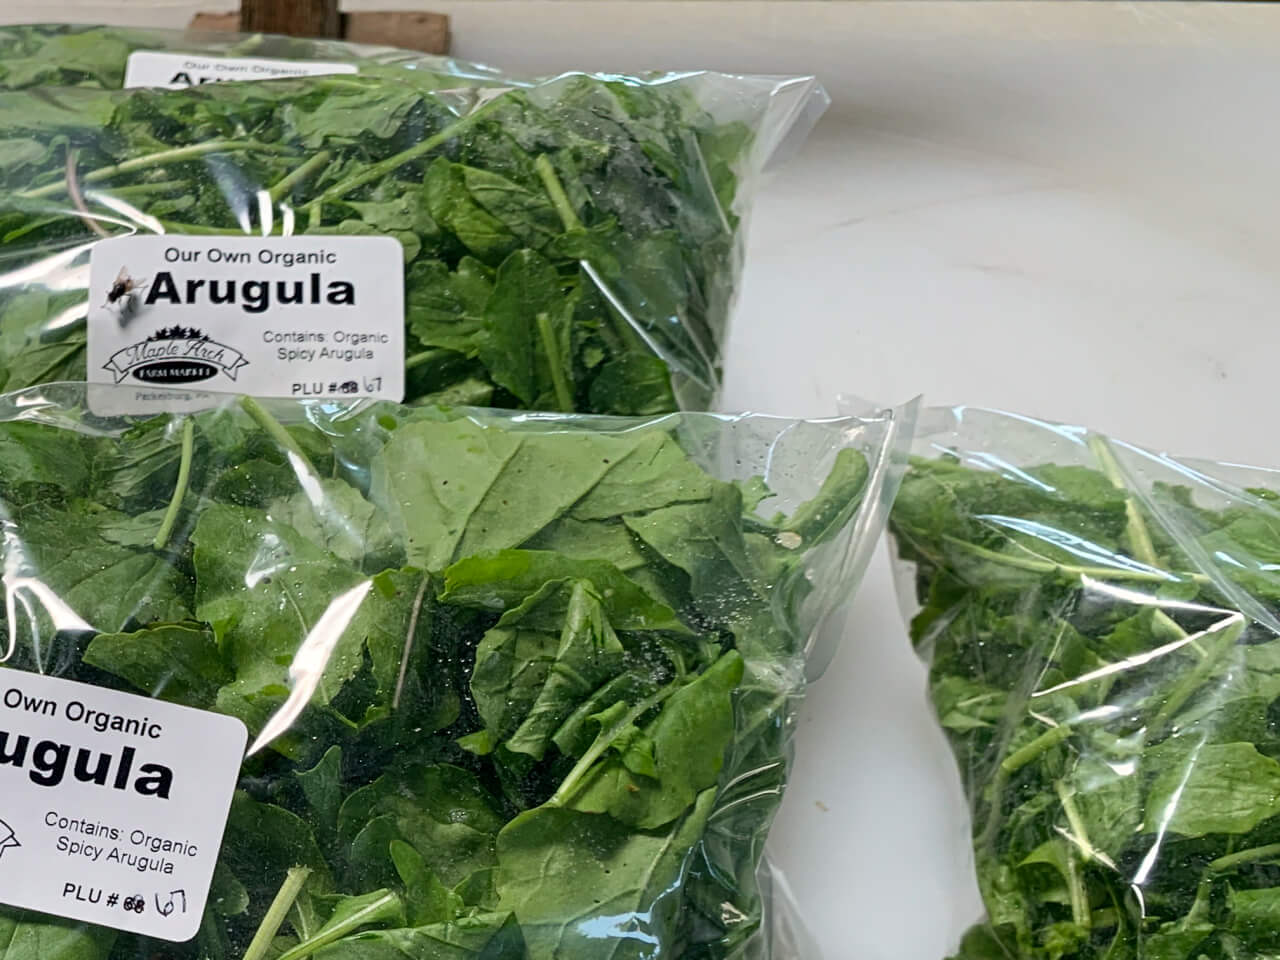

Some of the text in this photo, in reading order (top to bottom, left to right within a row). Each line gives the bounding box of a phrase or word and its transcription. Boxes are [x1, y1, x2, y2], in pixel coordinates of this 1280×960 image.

[164, 247, 337, 267] Our Own Organic
[144, 271, 355, 314] Arugula
[333, 331, 389, 345] Organic
[126, 340, 179, 365] Maple
[277, 347, 374, 362] Spicy Arugula
[292, 383, 323, 395] PLU
[4, 688, 57, 717] Own
[65, 700, 162, 739] Organic
[45, 811, 198, 857] Contains: Organic
[56, 836, 174, 875] Spicy Arugula
[62, 882, 102, 904] PLU
